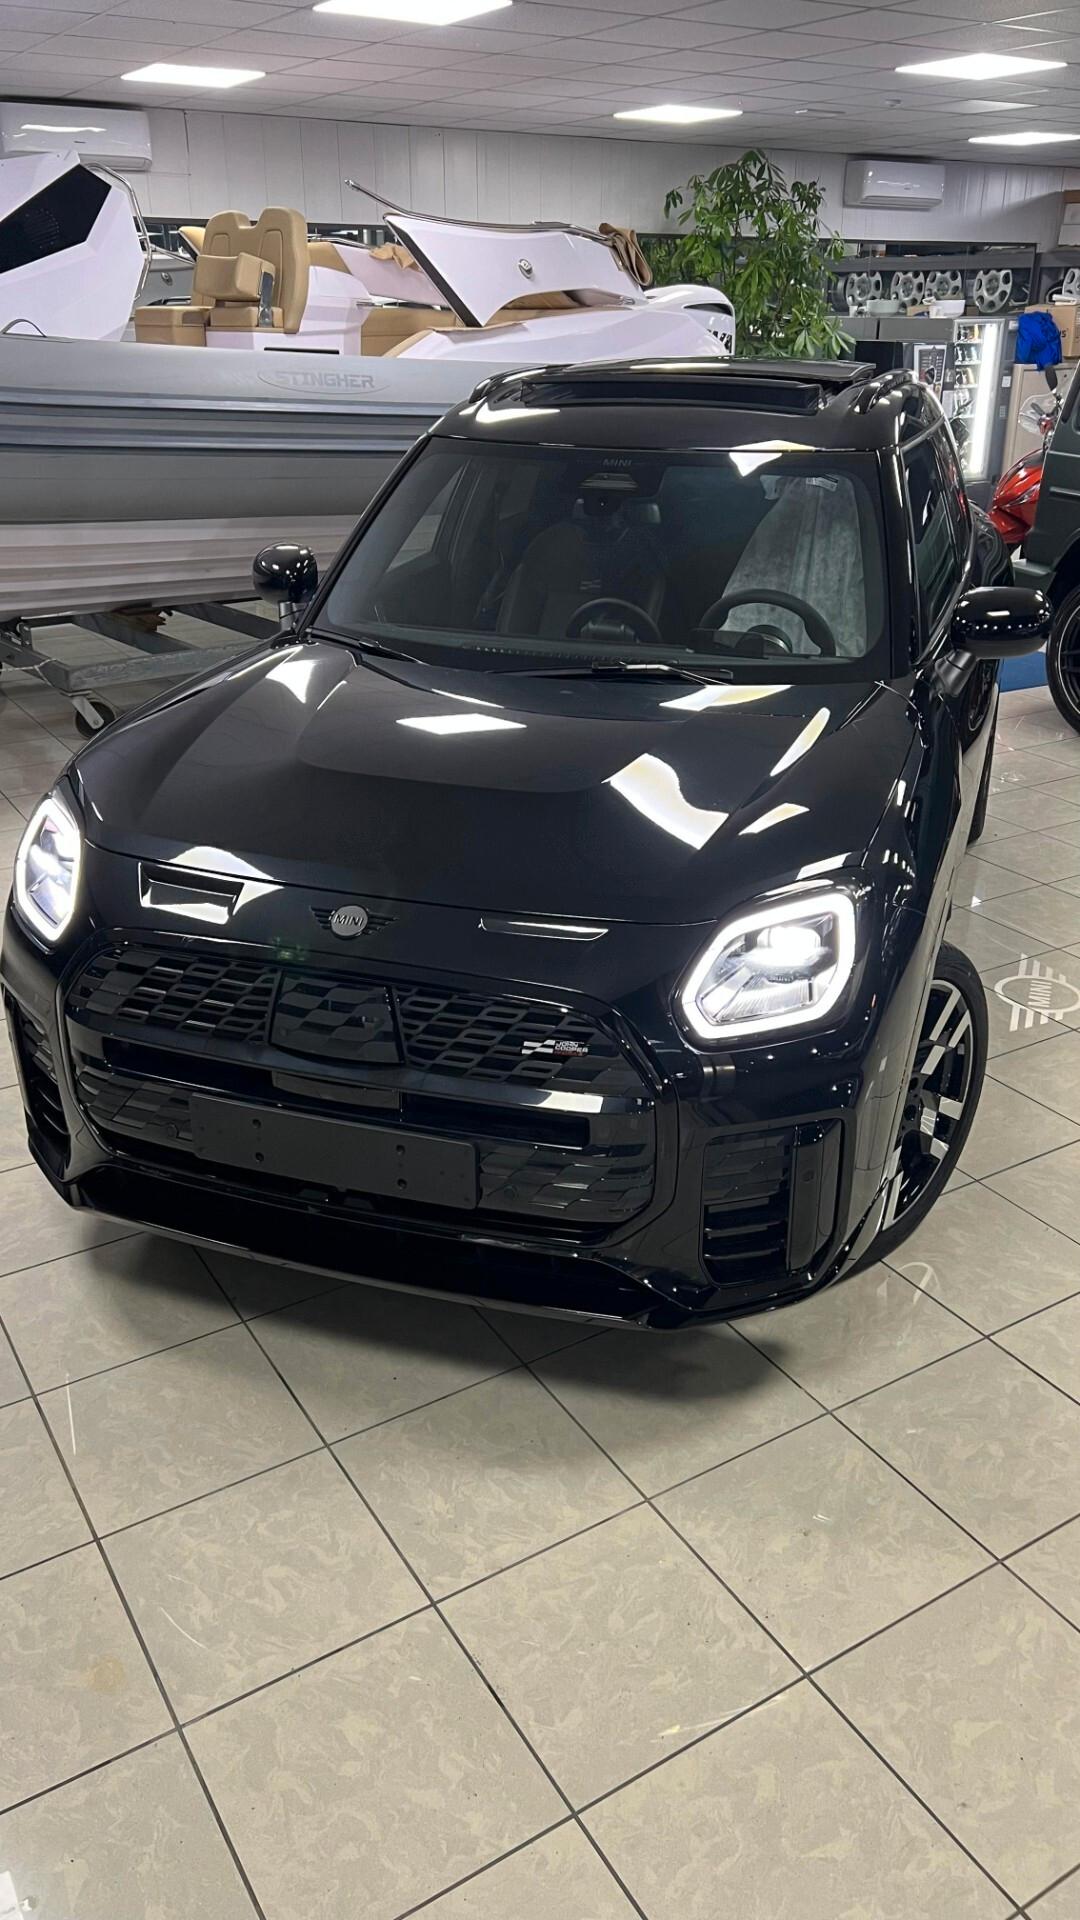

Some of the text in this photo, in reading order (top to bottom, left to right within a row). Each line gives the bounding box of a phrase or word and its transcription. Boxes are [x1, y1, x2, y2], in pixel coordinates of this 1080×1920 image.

[275, 371, 375, 388] STINGHER
[333, 914, 364, 926] MINI
[1027, 980, 1052, 1008] MINI
